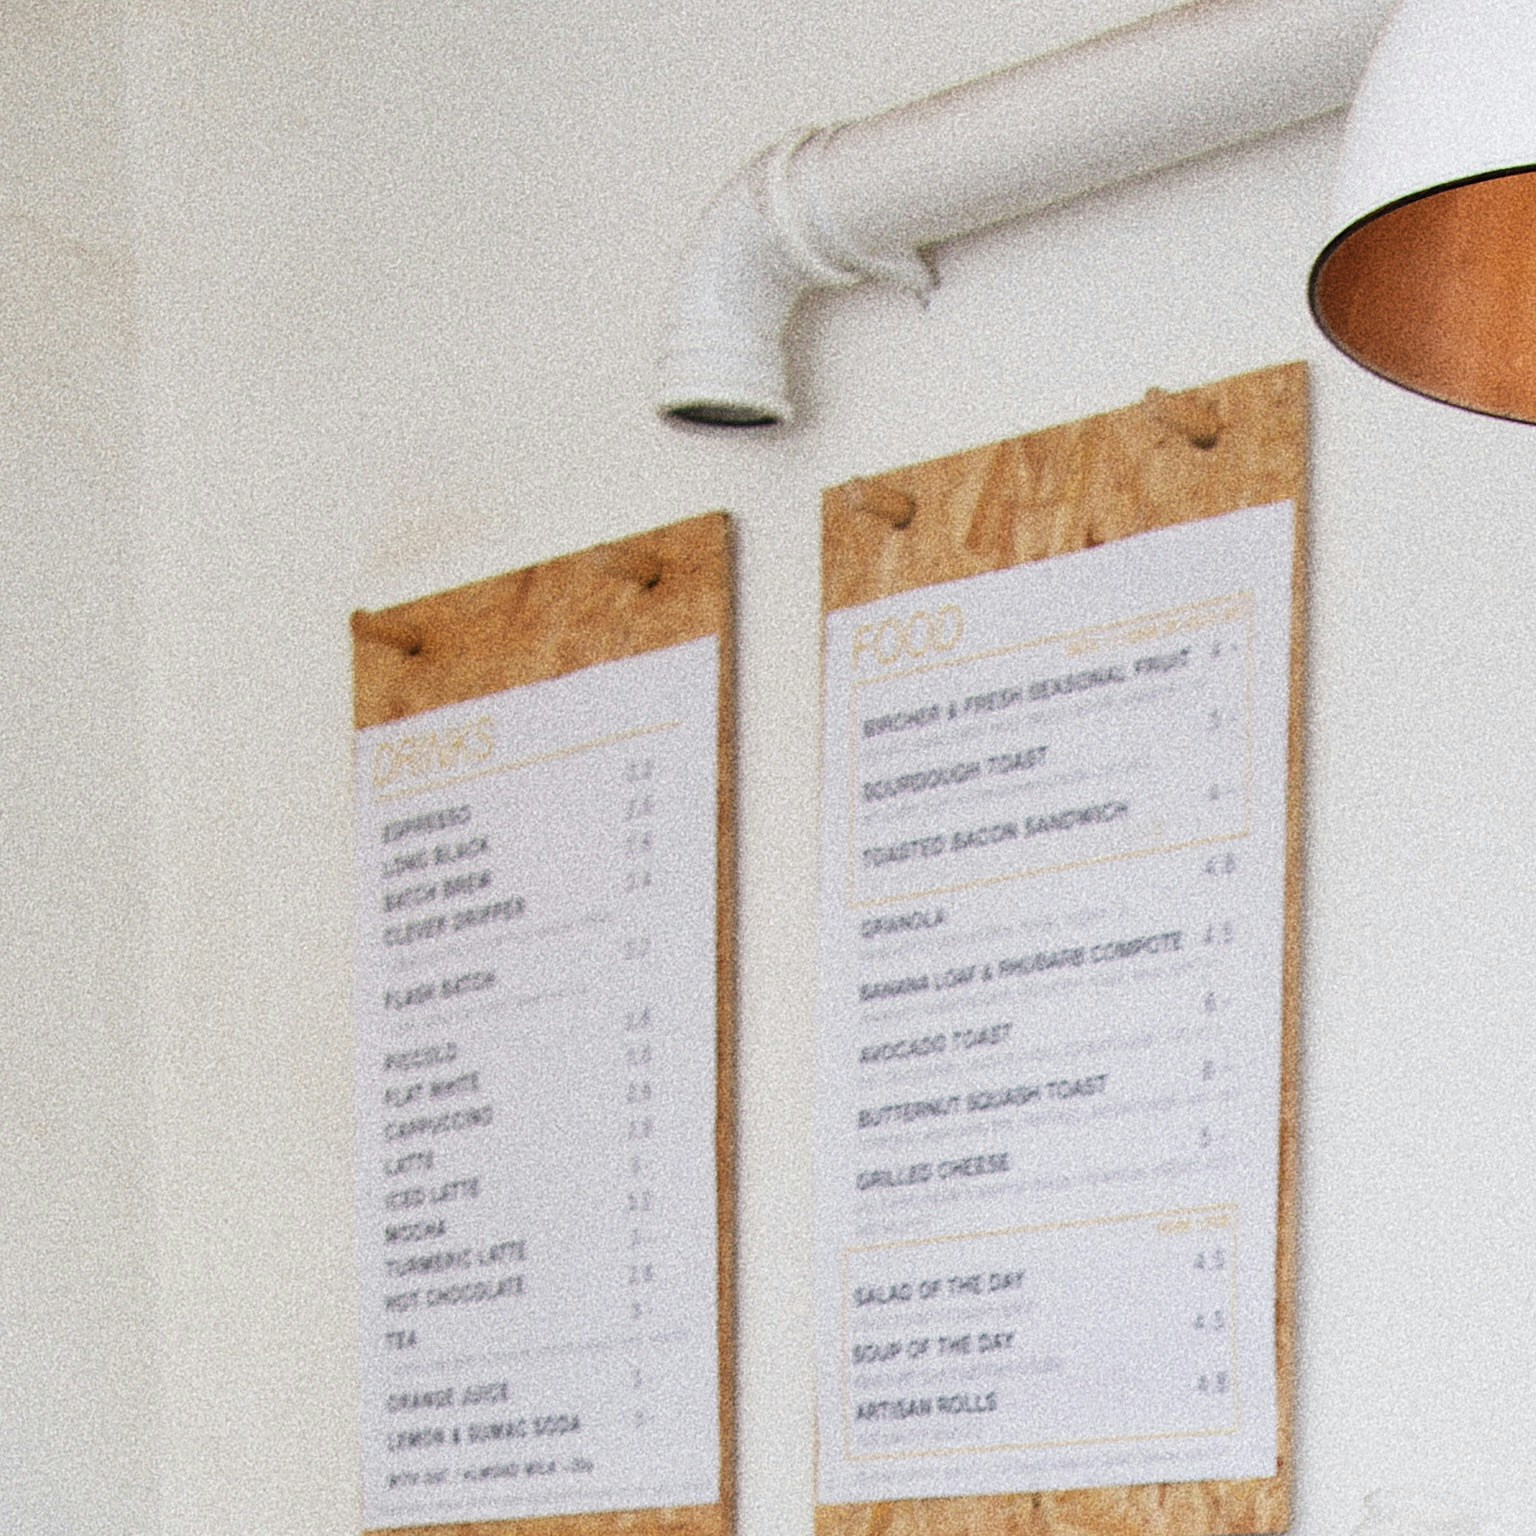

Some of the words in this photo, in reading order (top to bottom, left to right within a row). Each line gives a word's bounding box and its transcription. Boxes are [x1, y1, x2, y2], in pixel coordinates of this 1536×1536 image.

[852, 603, 964, 671] FOOD
[862, 703, 940, 739] BIRCHER
[947, 700, 957, 720] &
[963, 685, 1022, 716] FRESH
[1029, 661, 1126, 702] SEASONAL
[1134, 646, 1192, 678] FRUIT
[373, 716, 495, 788] DRINKS
[862, 758, 982, 803] SOURDOUGH
[987, 745, 1047, 776] TOAST
[381, 804, 471, 844] ESPRESSO
[861, 834, 947, 870] TOASTED
[951, 820, 1018, 852] BACON
[1023, 798, 1129, 838] SANDWICH
[382, 851, 427, 879] LONG
[433, 835, 489, 866] BLACK
[382, 883, 436, 913] BATCH
[443, 870, 491, 899] BREW
[383, 916, 445, 947] CLEVER
[453, 897, 525, 933] DRIPPER
[860, 905, 945, 941] GRANOLA
[859, 973, 929, 1004] BANANA
[934, 965, 976, 991] LOAF
[981, 962, 992, 983] &
[998, 946, 1084, 980] RHUBARB
[1089, 930, 1182, 965] COMPOTE
[384, 982, 434, 1012] FLASH
[440, 969, 495, 1000] BATCH
[383, 1041, 458, 1075] PICCOLO
[859, 1033, 946, 1066] AVOCADO
[953, 1022, 1011, 1050] TOAST
[384, 1082, 423, 1109] FLAT
[429, 1071, 479, 1098] WHITE
[857, 1095, 960, 1129] BUTTERNUT
[966, 1083, 1041, 1113] SQUASH
[1046, 1073, 1107, 1101] TOAST
[384, 1104, 493, 1142] CAPPUCCINO
[385, 1150, 434, 1176] LATTE
[856, 1162, 932, 1191] GRILLED
[938, 1151, 1010, 1180] CHEESE
[385, 1188, 424, 1211] ICED
[430, 1178, 479, 1204] LATTE
[385, 1218, 446, 1245] MOCHA
[385, 1248, 471, 1279] TURMERIC
[477, 1240, 526, 1266] LATTE
[384, 1291, 419, 1314] HOT
[426, 1275, 523, 1307] CHOCOLATE
[853, 1281, 911, 1308] SALAD
[918, 1278, 941, 1300] OF
[947, 1274, 982, 1297] THE
[987, 1269, 1025, 1293] DAY
[384, 1329, 416, 1350] TEA
[853, 1341, 902, 1365] SOUP
[906, 1338, 931, 1359] OF
[936, 1334, 972, 1356] THE
[978, 1330, 1015, 1352] DAY
[385, 1388, 453, 1414] ORANGE
[461, 1381, 509, 1404] JUICE
[855, 1397, 932, 1422] ARTISAN
[937, 1391, 997, 1415] ROLLS
[387, 1427, 444, 1451] LEMON
[451, 1425, 460, 1443] &
[467, 1417, 527, 1442] SUMAC
[533, 1411, 580, 1435] SODA
[461, 1461, 519, 1482] ALMOND
